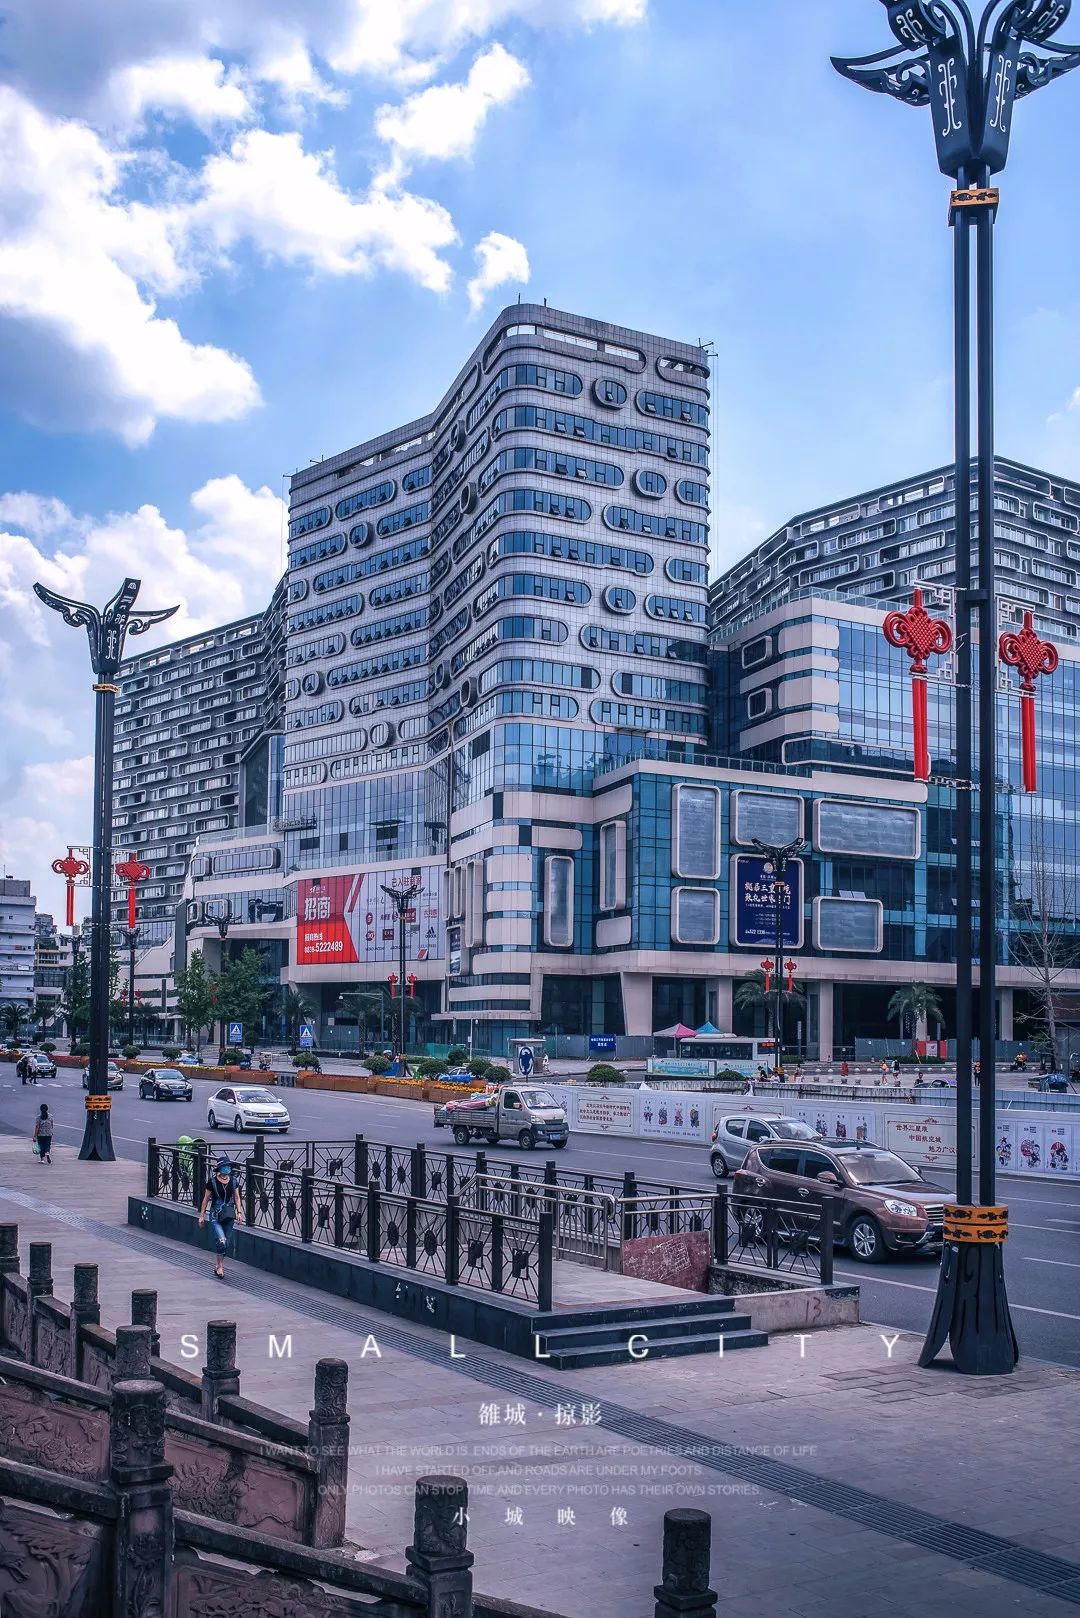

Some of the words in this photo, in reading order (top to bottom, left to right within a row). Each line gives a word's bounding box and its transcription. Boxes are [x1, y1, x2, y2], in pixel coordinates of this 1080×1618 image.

[304, 896, 330, 921] 招商
[908, 1134, 942, 1143] 中国航空城
